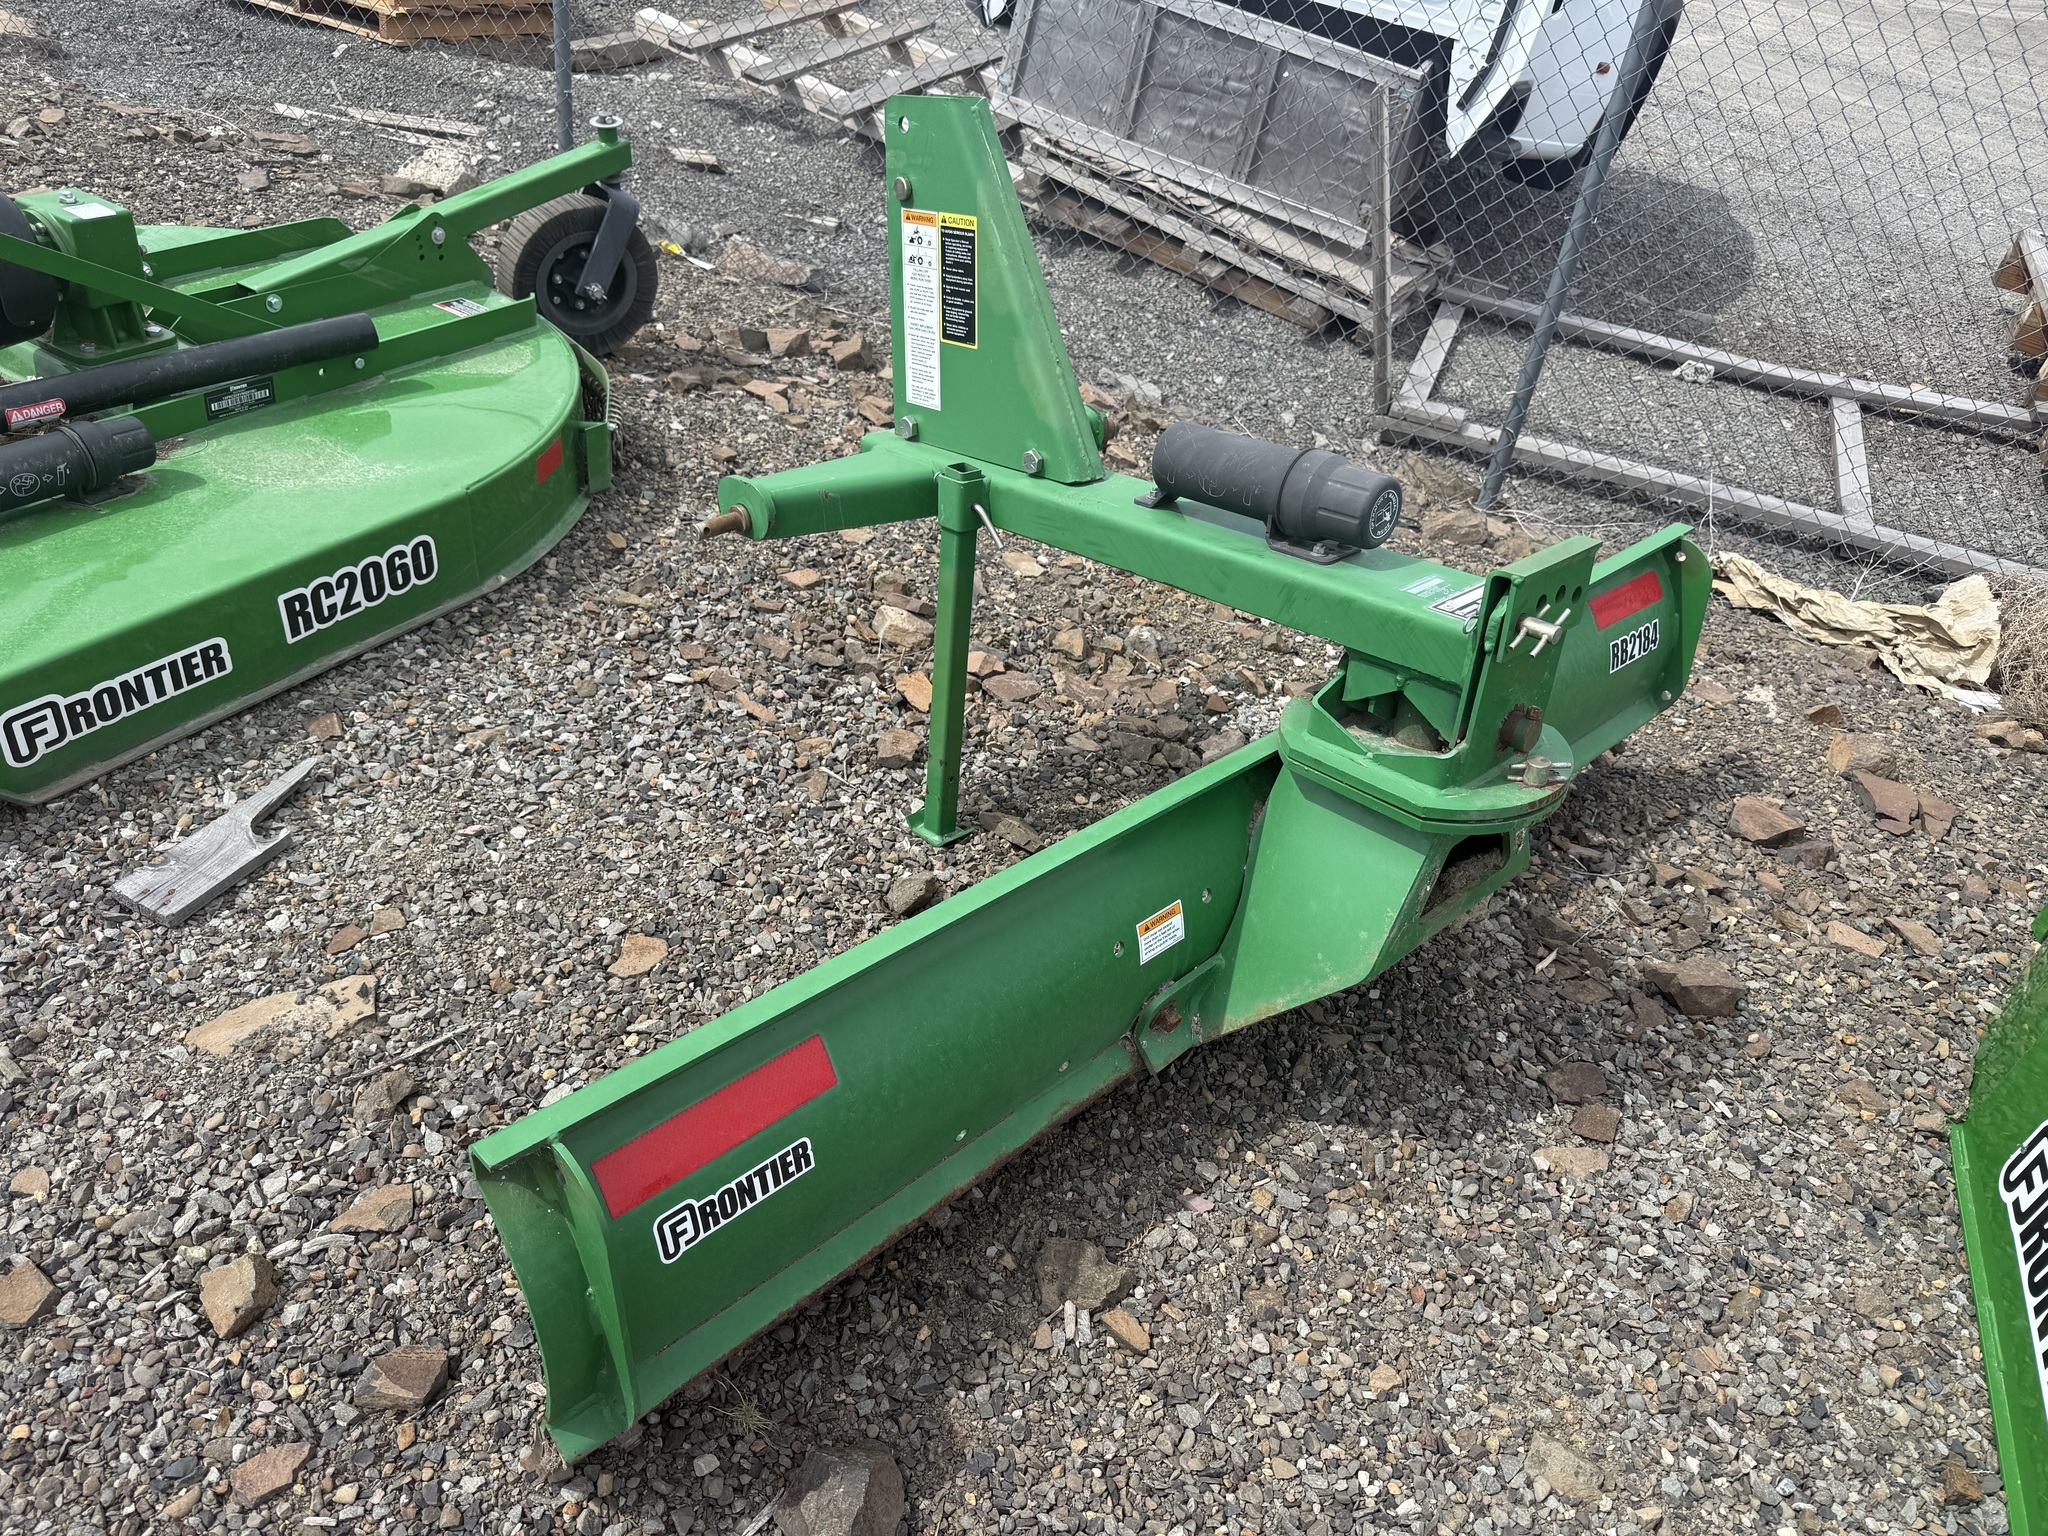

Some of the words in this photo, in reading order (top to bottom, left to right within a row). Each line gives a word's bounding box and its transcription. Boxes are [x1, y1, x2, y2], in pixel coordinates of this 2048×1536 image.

[911, 214, 934, 224] WARNING
[947, 216, 975, 227] CAUTION
[22, 402, 63, 419] DANGER
[282, 539, 435, 640] RC2060
[1610, 620, 1659, 672] RB2184
[2, 642, 228, 764] FRONTIER
[1149, 908, 1176, 928] WARNING
[656, 1139, 813, 1261] FRONTIER
